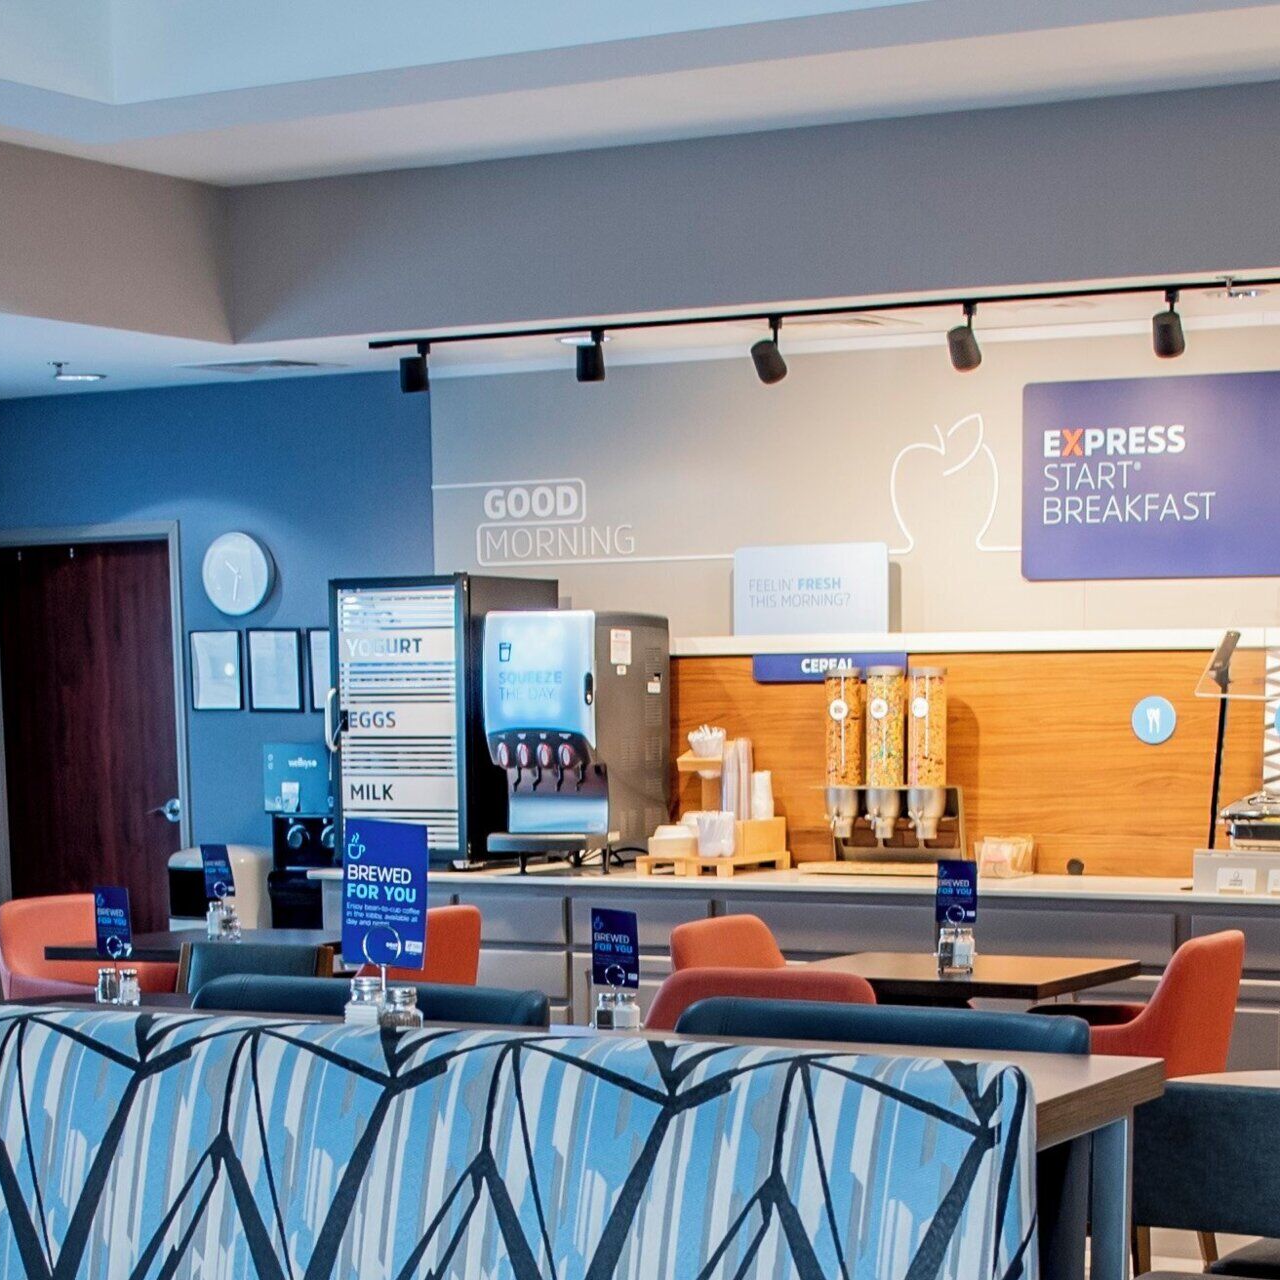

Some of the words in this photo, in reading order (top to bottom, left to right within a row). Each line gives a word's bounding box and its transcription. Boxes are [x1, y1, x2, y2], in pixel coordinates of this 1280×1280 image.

[1044, 425, 1186, 458] EXPRESS
[1044, 461, 1131, 492] START
[483, 486, 578, 521] GOOD
[1043, 491, 1216, 525] BREAKFAST
[485, 524, 636, 560] MORNING
[748, 576, 794, 592] FEELIN'
[797, 576, 842, 592] FRESH
[748, 592, 777, 608] THIS
[780, 590, 851, 607] MORNING?
[346, 637, 423, 657] YOGURT
[498, 670, 562, 685] SQUEEZE
[349, 711, 397, 729] EGGS
[350, 782, 394, 801] MILK
[347, 863, 412, 885] BREWED
[346, 882, 379, 900] FOR
[384, 885, 417, 903] YOU
[593, 931, 630, 944] BREWED
[594, 942, 612, 952] FOR
[614, 943, 633, 954] YOU
